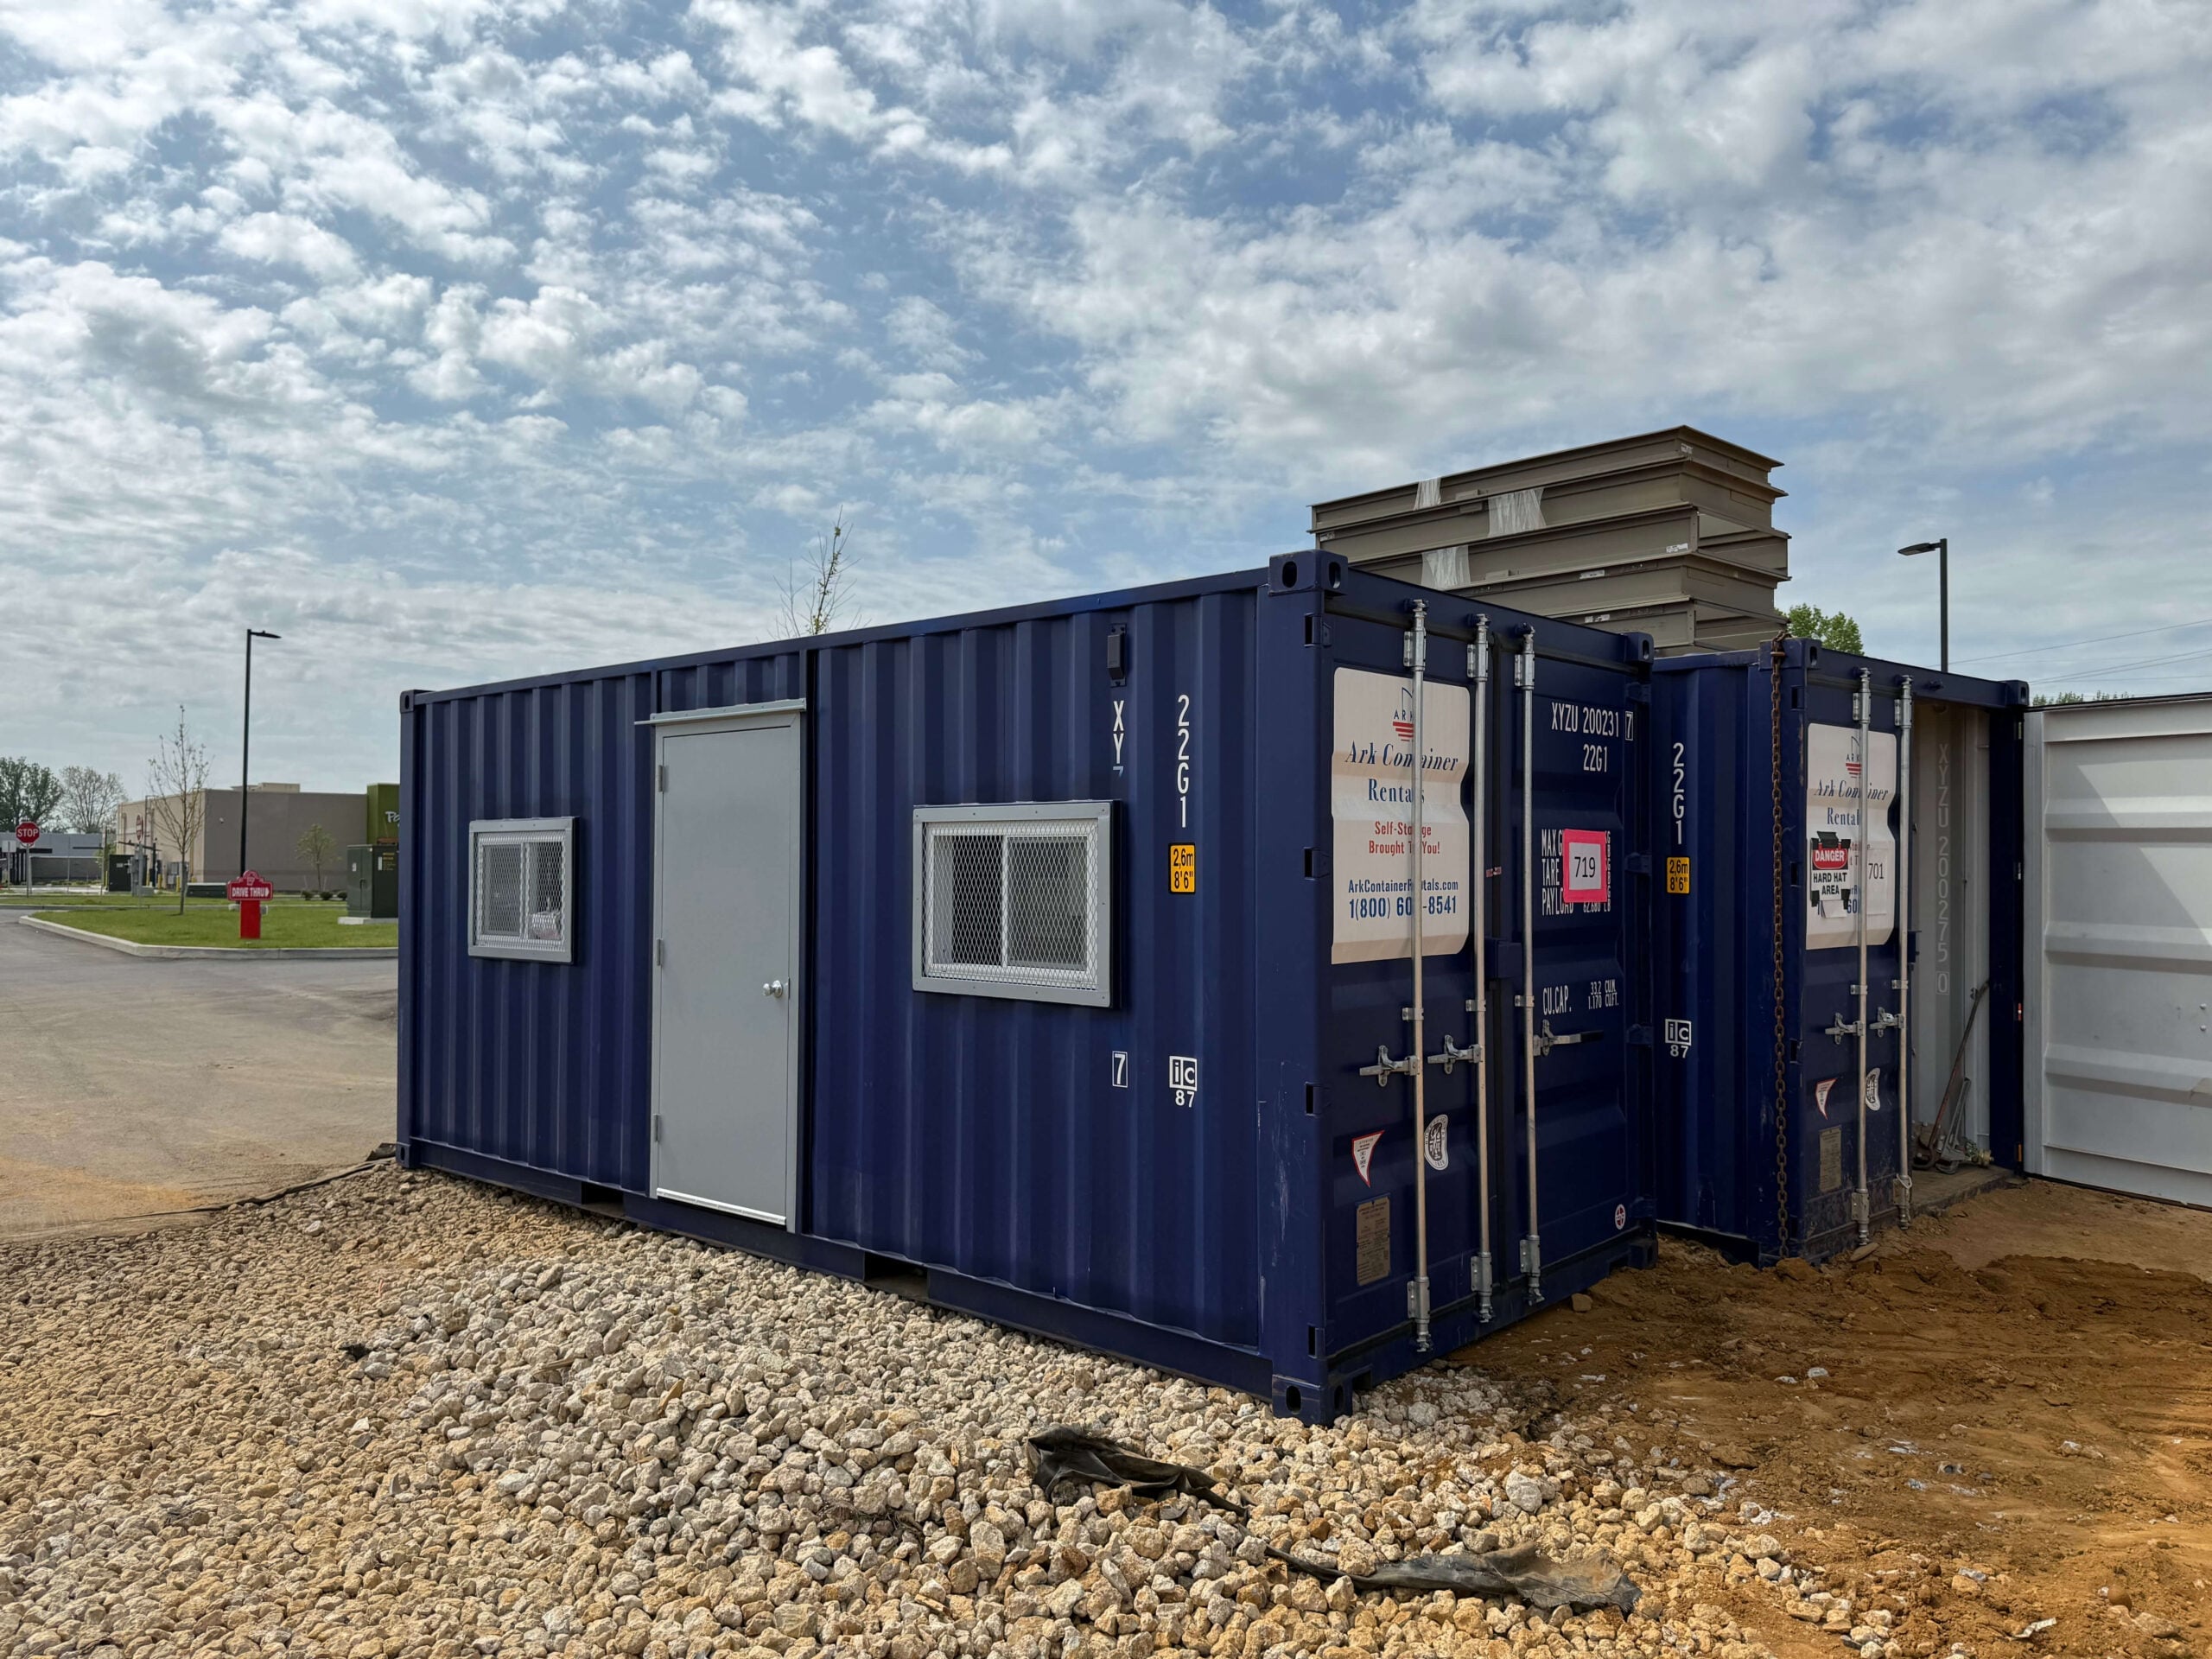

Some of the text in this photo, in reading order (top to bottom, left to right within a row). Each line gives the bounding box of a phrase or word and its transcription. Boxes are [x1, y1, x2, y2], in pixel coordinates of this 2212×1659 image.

[1551, 702, 1633, 740] XYZU 200231 7
[1177, 694, 1190, 829] 22G1
[1345, 740, 1377, 765] Ark
[1583, 743, 1607, 772] 22G1
[1672, 741, 1685, 845] 22G1
[1814, 779, 1836, 797] Ark
[17, 828, 39, 837] STOP
[1369, 841, 1405, 856] Brought
[1422, 842, 1440, 854] You!
[1541, 829, 1556, 857] MAX
[1815, 849, 1845, 862] DANGER
[1541, 858, 1560, 887] TARE
[1574, 856, 1596, 878] 719
[1868, 862, 1885, 880] 701
[1813, 872, 1847, 883] HARD HAT
[232, 887, 265, 897] DRIVE THRU
[1821, 885, 1840, 895] AREA
[1350, 895, 1457, 921] 1(800) 60-8541
[1542, 985, 1572, 1015] CU.CAP.
[1669, 1044, 1688, 1058] 87
[1174, 1090, 1195, 1109] 87
